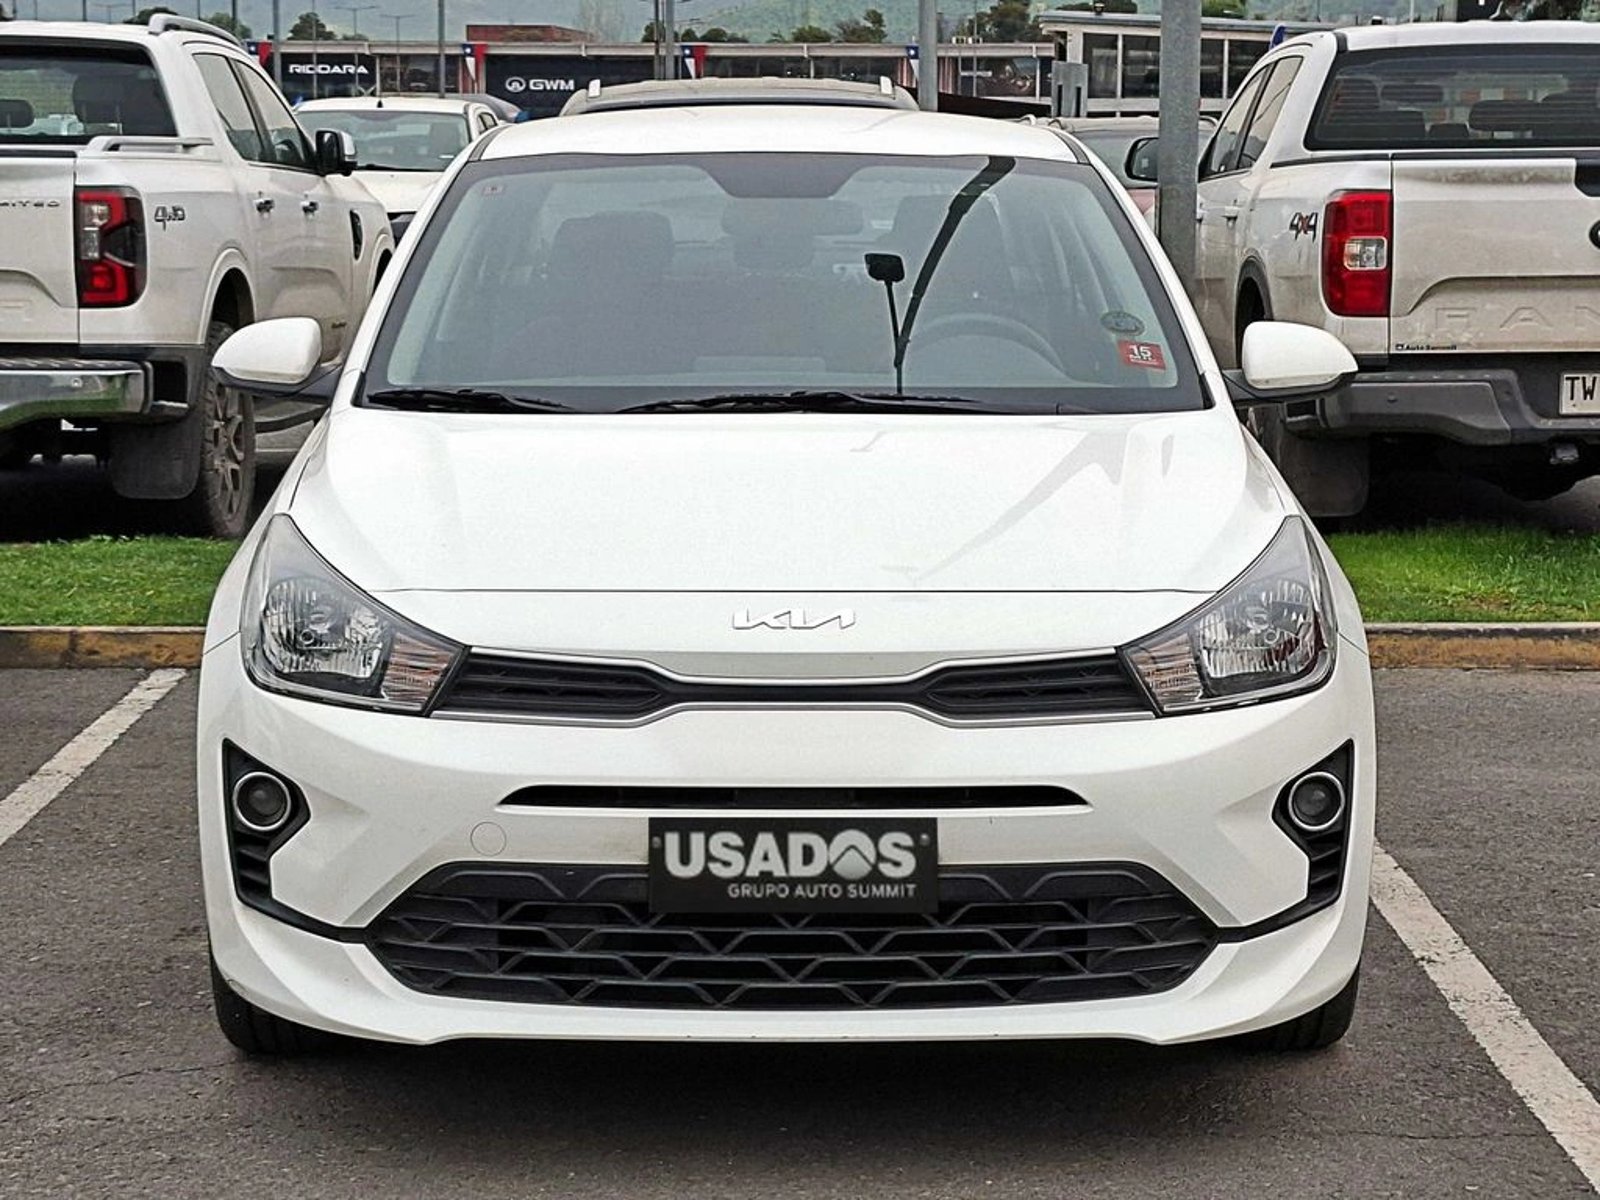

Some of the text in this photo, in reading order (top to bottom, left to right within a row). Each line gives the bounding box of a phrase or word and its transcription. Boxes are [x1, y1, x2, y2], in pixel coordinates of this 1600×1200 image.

[529, 79, 575, 91] GWM
[1565, 376, 1597, 401] TW
[732, 608, 855, 630] KIA
[664, 829, 917, 880] USADOS
[727, 883, 917, 899] GRUPO AUTO SUMMIT
